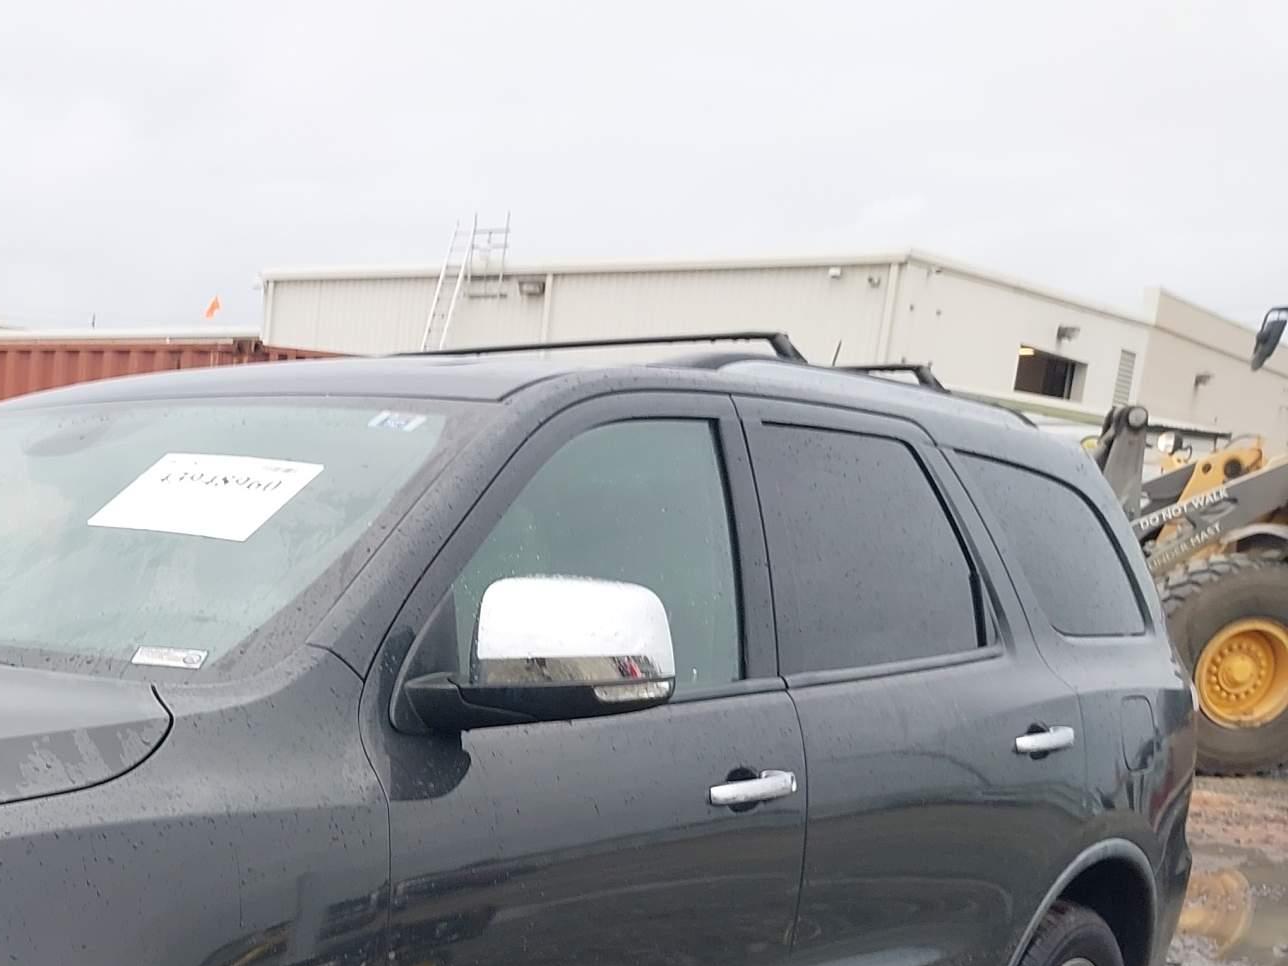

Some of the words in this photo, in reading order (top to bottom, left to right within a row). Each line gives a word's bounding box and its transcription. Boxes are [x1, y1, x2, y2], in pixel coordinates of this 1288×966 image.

[1140, 515, 1160, 530] DO
[1162, 503, 1189, 522] NOT
[1191, 487, 1229, 509] WALK
[1190, 521, 1220, 547] MAST
